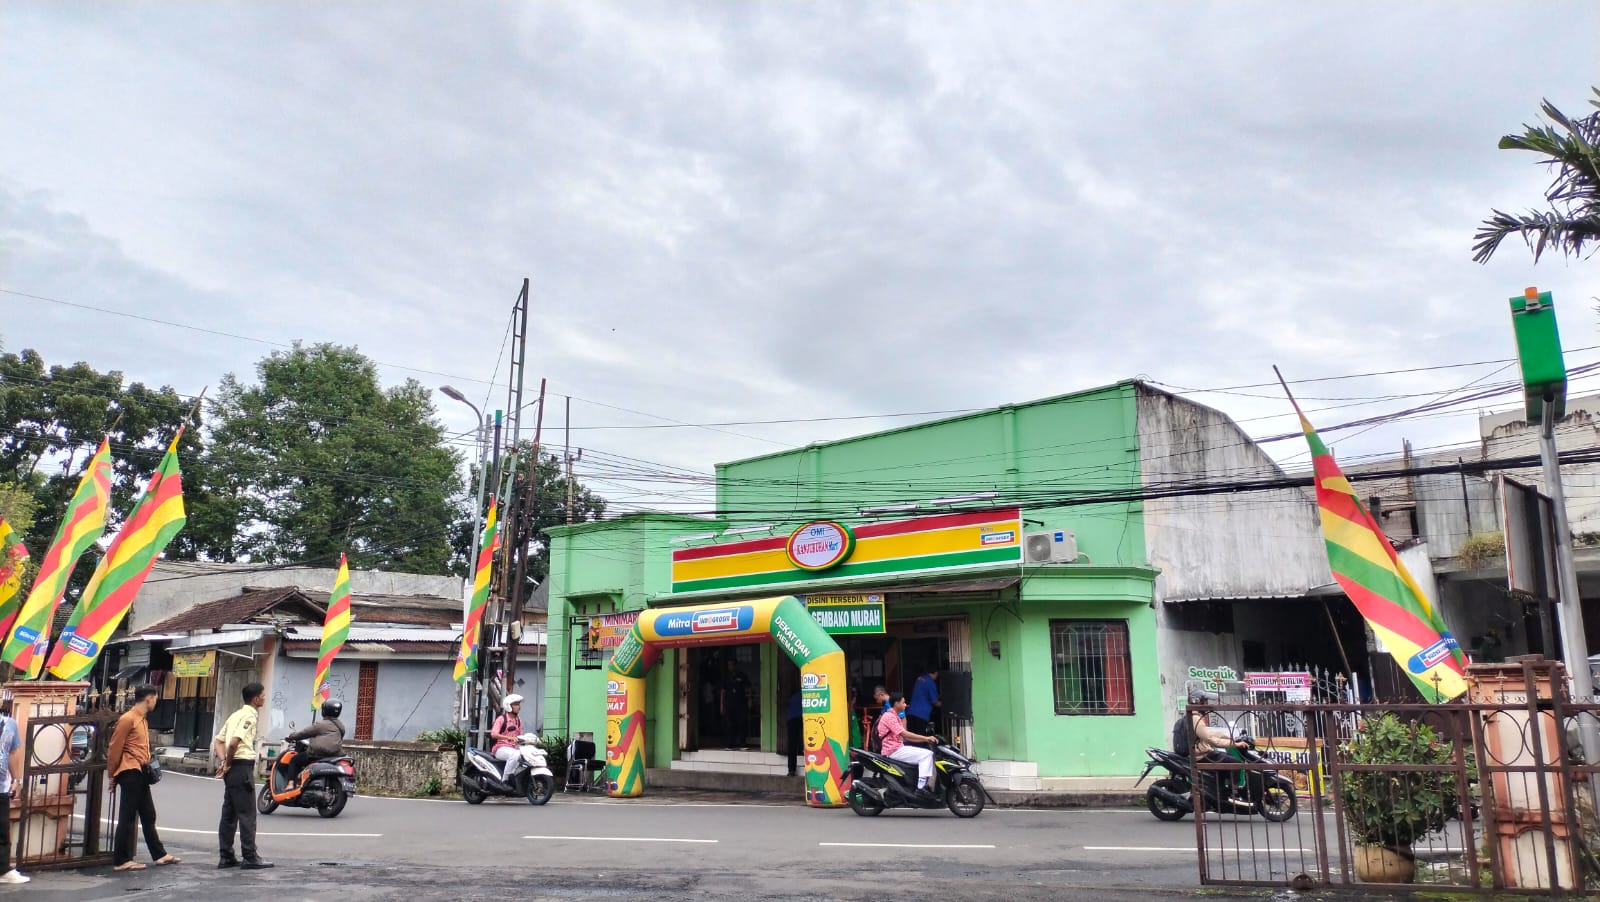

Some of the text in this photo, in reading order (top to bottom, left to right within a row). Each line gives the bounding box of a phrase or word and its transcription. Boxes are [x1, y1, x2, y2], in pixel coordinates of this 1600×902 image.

[810, 527, 825, 537] OMI
[807, 594, 864, 604] DISINI TERSEDIA
[668, 618, 690, 629] Mitra
[850, 609, 881, 626] MURAH
[774, 615, 811, 658] DEKAT DAN
[776, 631, 798, 657] HEMAT
